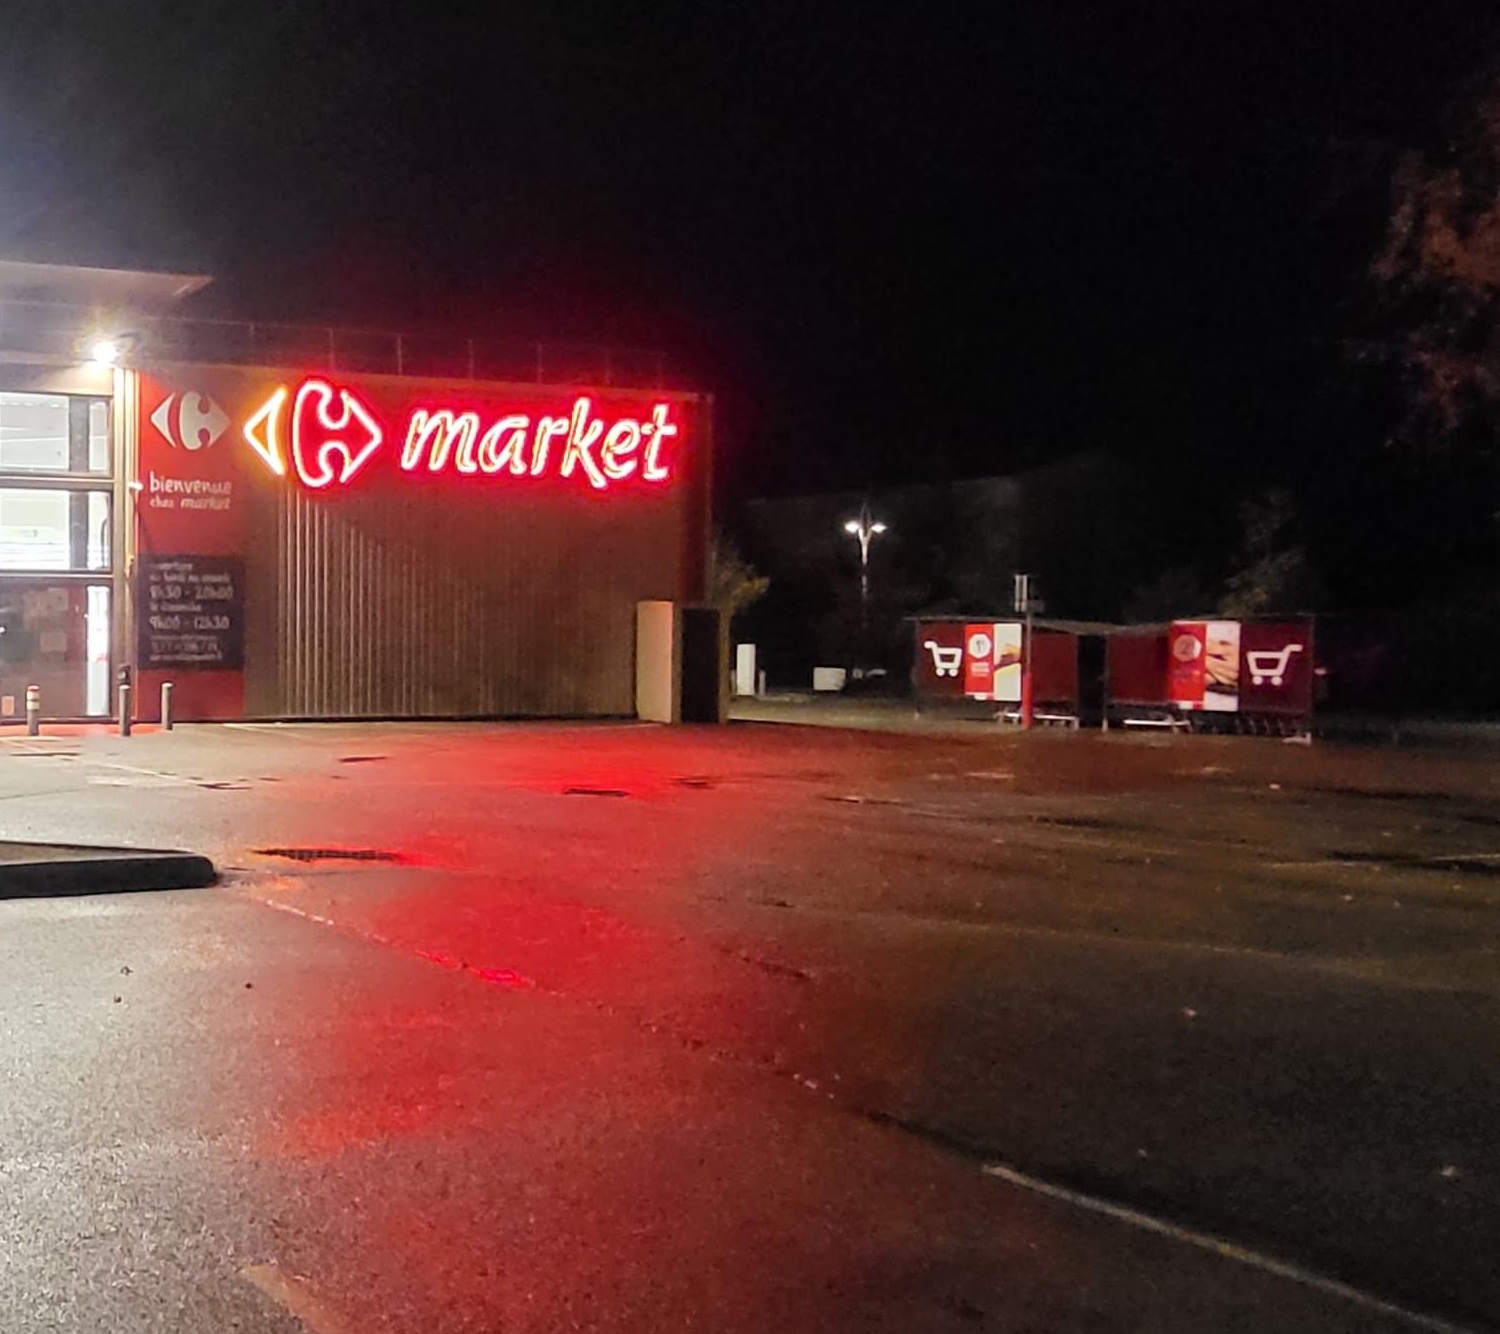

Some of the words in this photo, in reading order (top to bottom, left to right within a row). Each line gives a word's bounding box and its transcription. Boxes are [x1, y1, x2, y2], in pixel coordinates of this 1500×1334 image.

[400, 397, 677, 489] market
[149, 470, 232, 495] bienvenue
[180, 496, 231, 510] market
